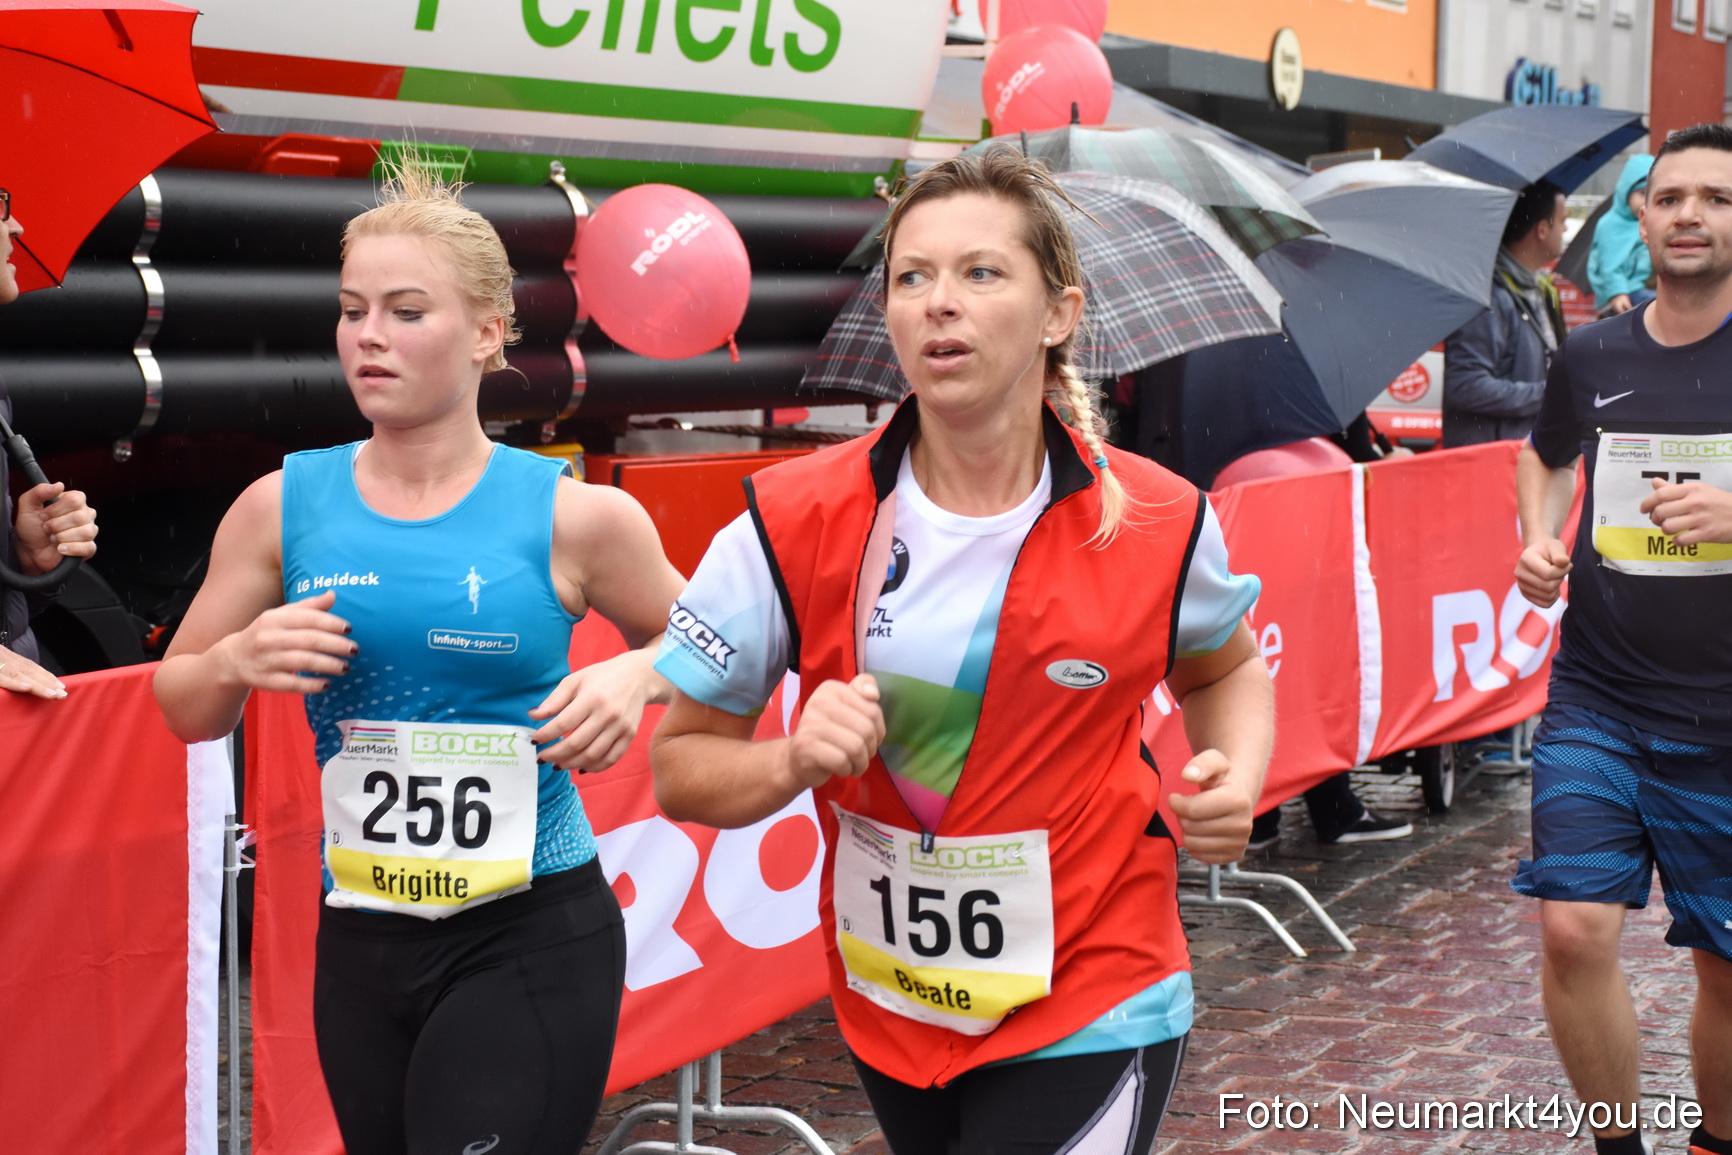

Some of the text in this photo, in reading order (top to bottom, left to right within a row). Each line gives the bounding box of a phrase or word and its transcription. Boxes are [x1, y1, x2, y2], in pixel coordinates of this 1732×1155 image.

[630, 211, 706, 276] RÖDL
[1608, 450, 1652, 459] NeuerMarkt
[297, 572, 380, 594] LG Heideck
[673, 634, 693, 653] smart
[692, 651, 725, 680] concepts
[344, 743, 399, 757] uerMarkt
[412, 731, 518, 757] BOCK
[411, 756, 443, 765] inspired
[445, 757, 456, 765] by
[483, 759, 520, 767] concepts
[362, 770, 492, 849] 256
[909, 841, 1027, 870] BOCK
[372, 865, 469, 902] Brigitte
[910, 867, 1029, 880] inspired by smart concepts
[870, 874, 1004, 959] 156
[894, 968, 972, 1010] Beate
